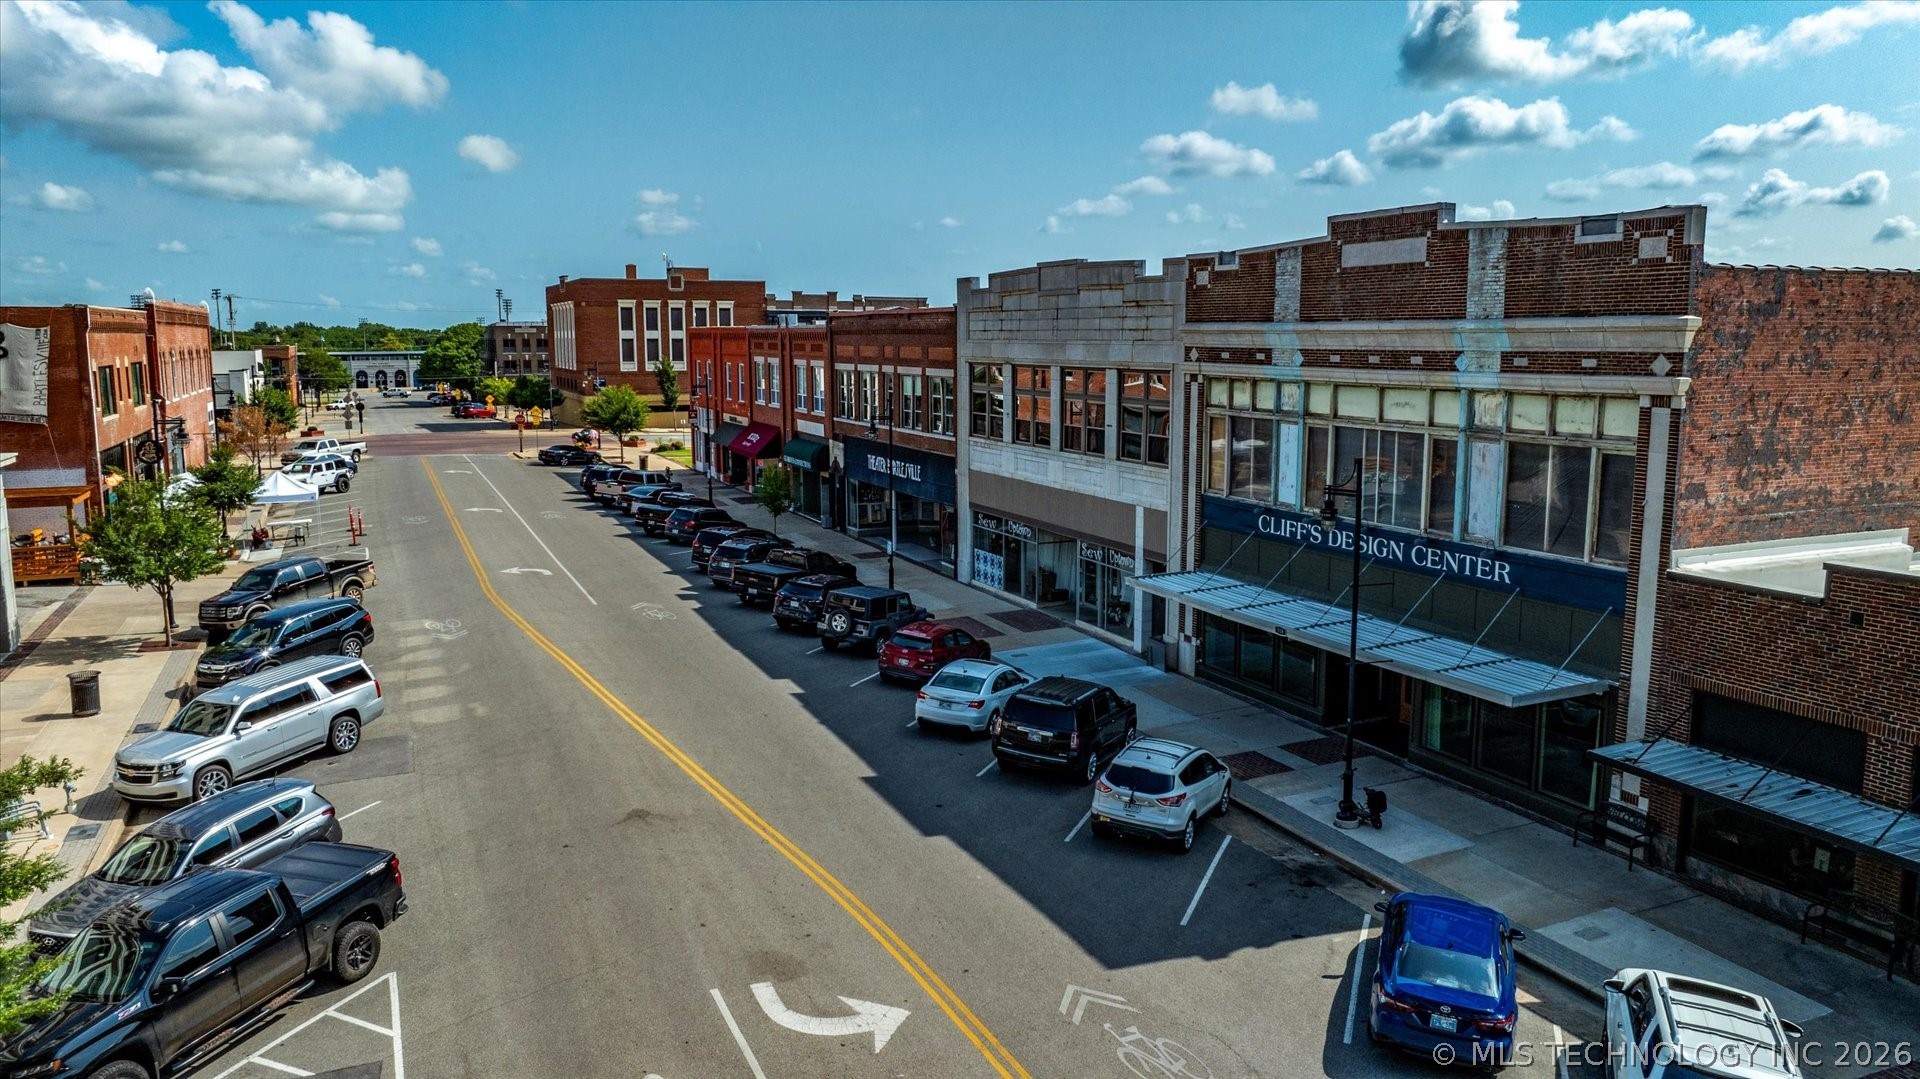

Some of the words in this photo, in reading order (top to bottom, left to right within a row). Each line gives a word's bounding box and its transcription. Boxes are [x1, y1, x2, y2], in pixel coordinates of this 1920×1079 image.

[978, 513, 997, 529] Sew
[1081, 542, 1103, 560] Sew
[1258, 514, 1322, 544] CLIFF'S
[1328, 528, 1404, 563] DESIGN
[1411, 545, 1511, 584] CENTER
